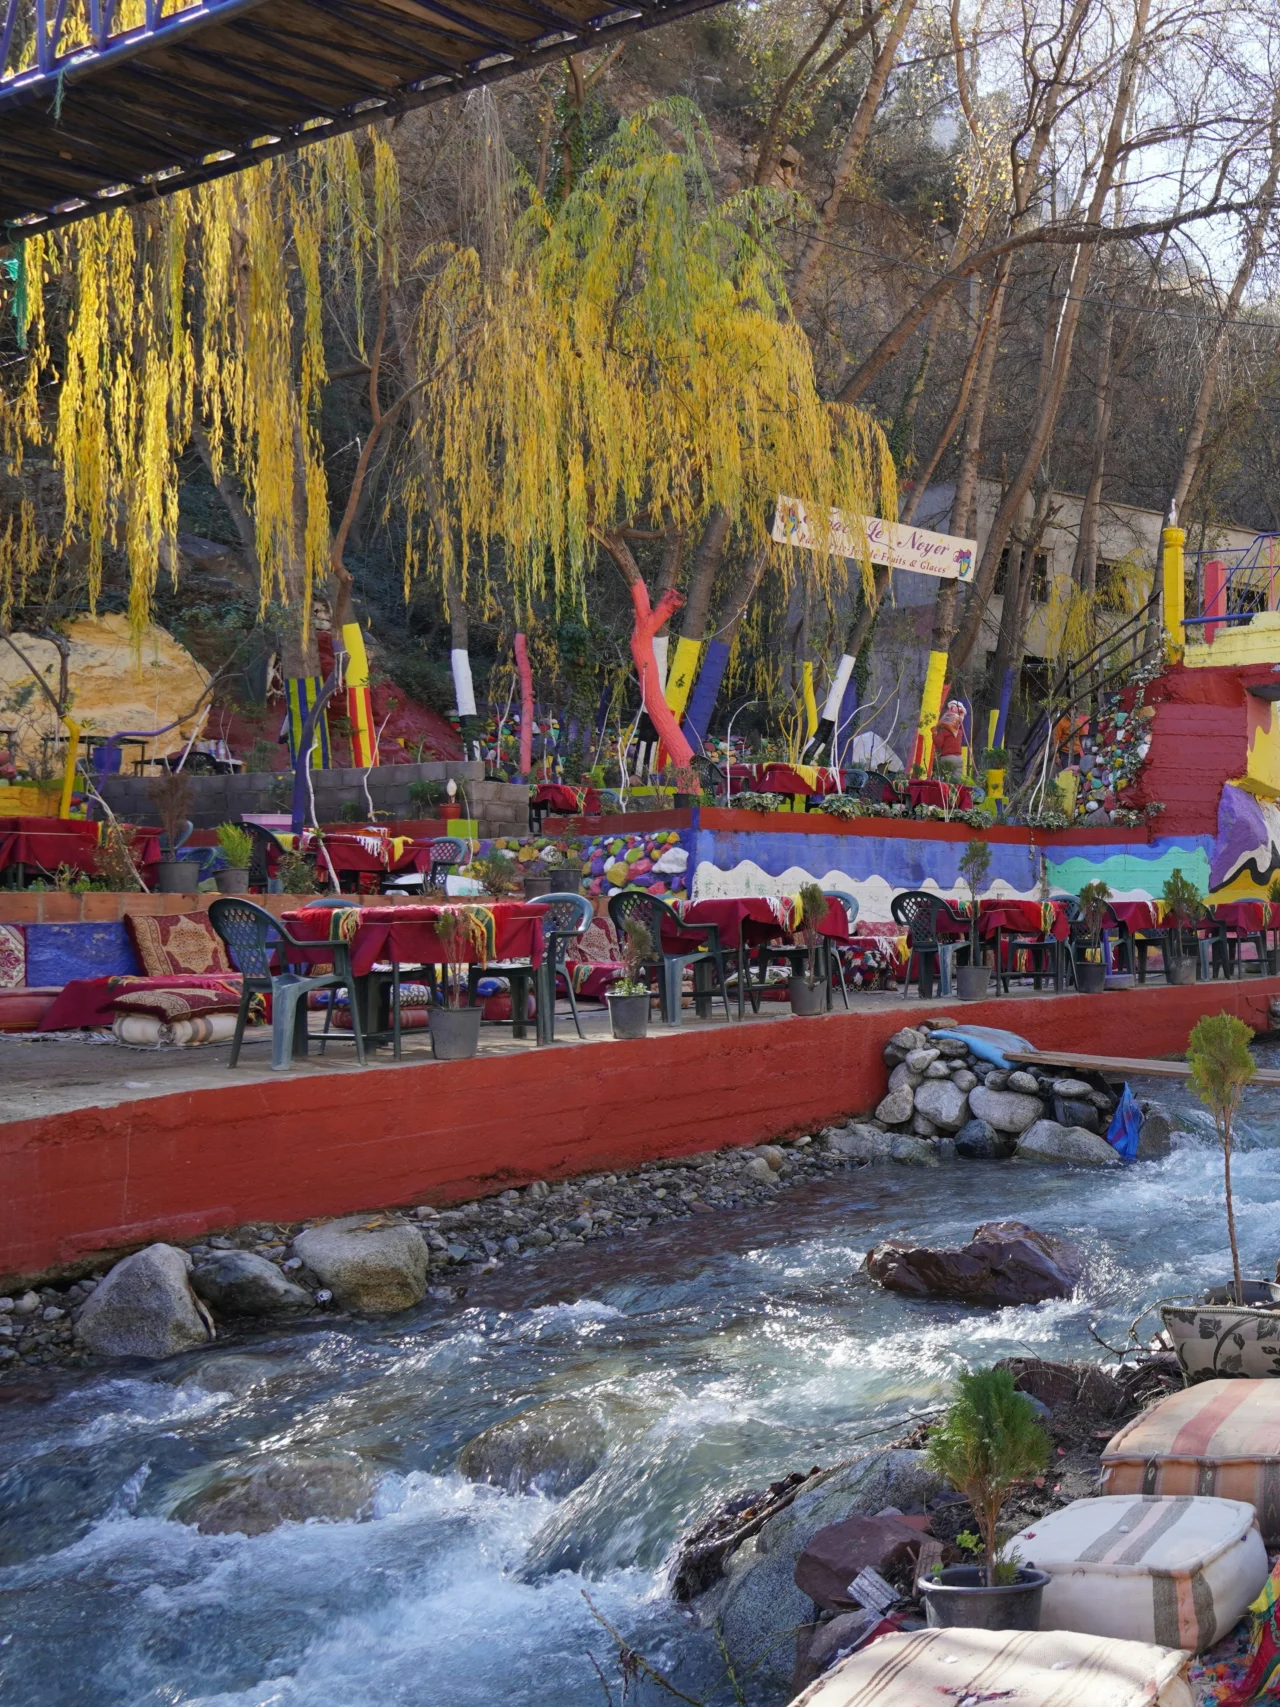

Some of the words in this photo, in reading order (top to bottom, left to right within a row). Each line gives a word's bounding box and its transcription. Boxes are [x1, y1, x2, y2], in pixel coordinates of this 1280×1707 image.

[866, 520, 889, 547] Le
[897, 531, 950, 557] Noyer
[881, 552, 906, 566] Fruits
[909, 559, 917, 568] &
[920, 561, 946, 574] Glaces
